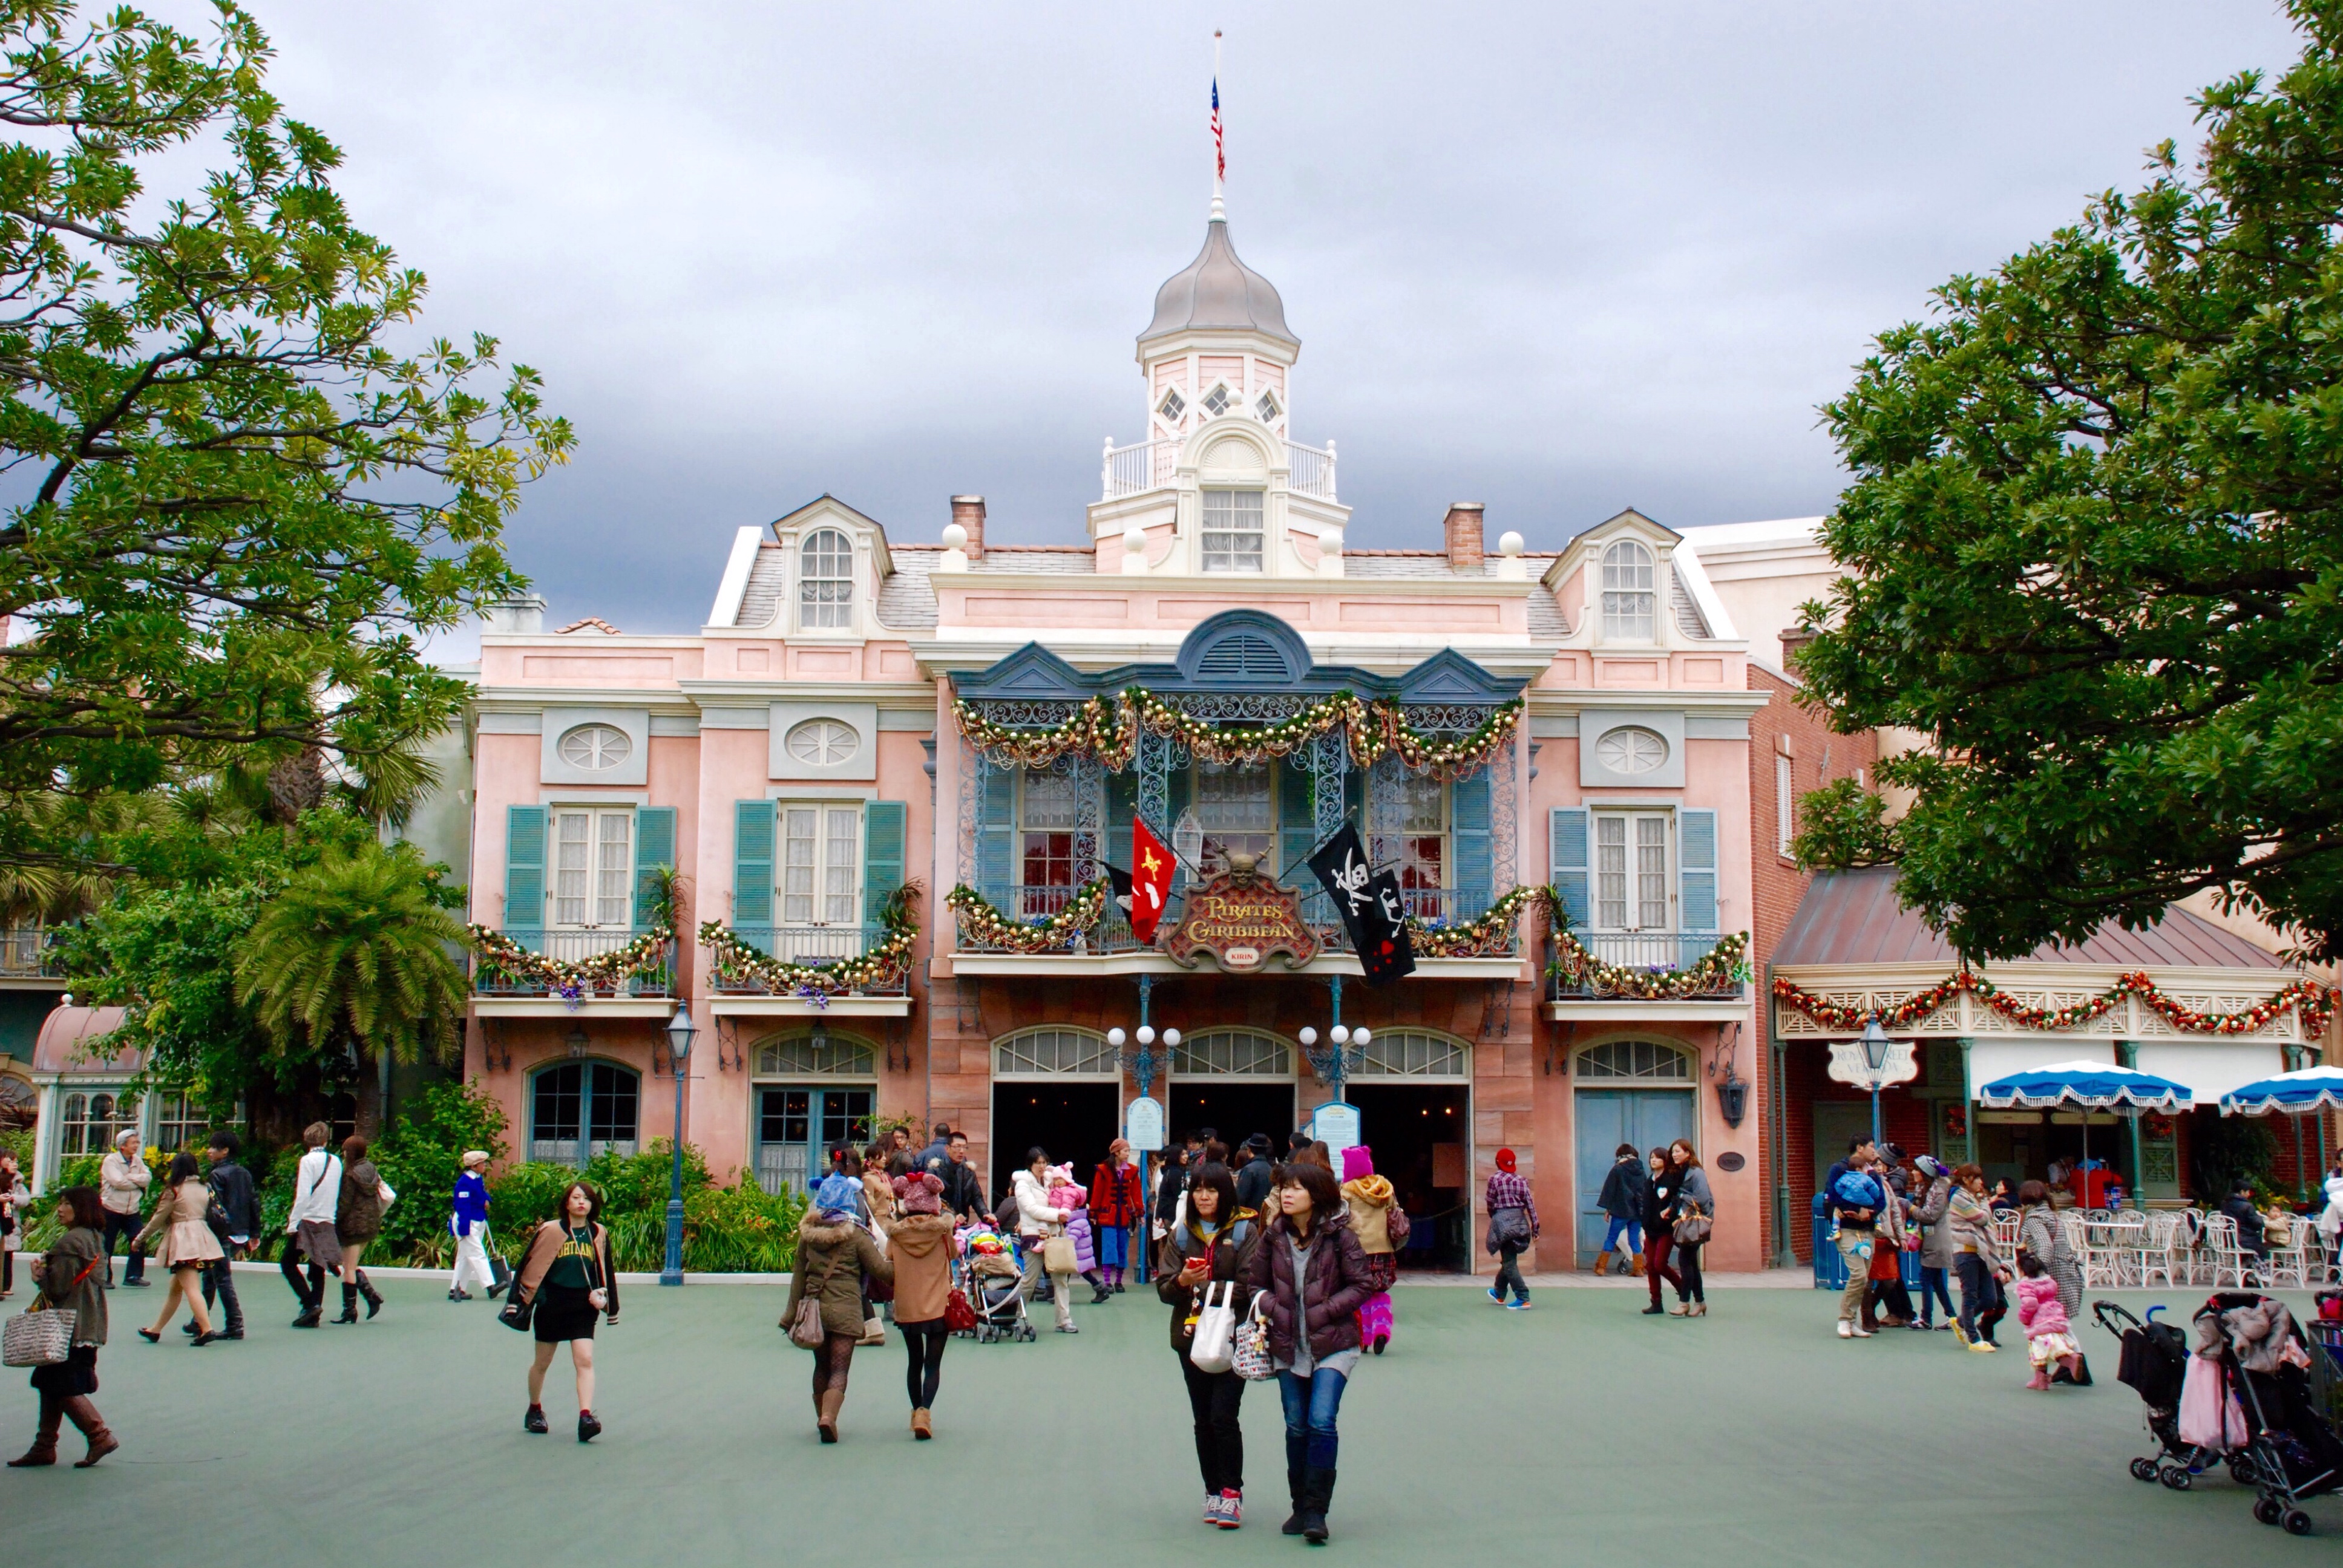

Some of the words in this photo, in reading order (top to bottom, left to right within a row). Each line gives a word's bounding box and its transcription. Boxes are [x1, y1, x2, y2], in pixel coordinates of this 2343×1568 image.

[1202, 897, 1283, 923] PIRATES
[1188, 920, 1300, 942] CARIBBEAN
[1837, 1048, 1856, 1060] ROY
[1887, 1049, 1909, 1060] REET
